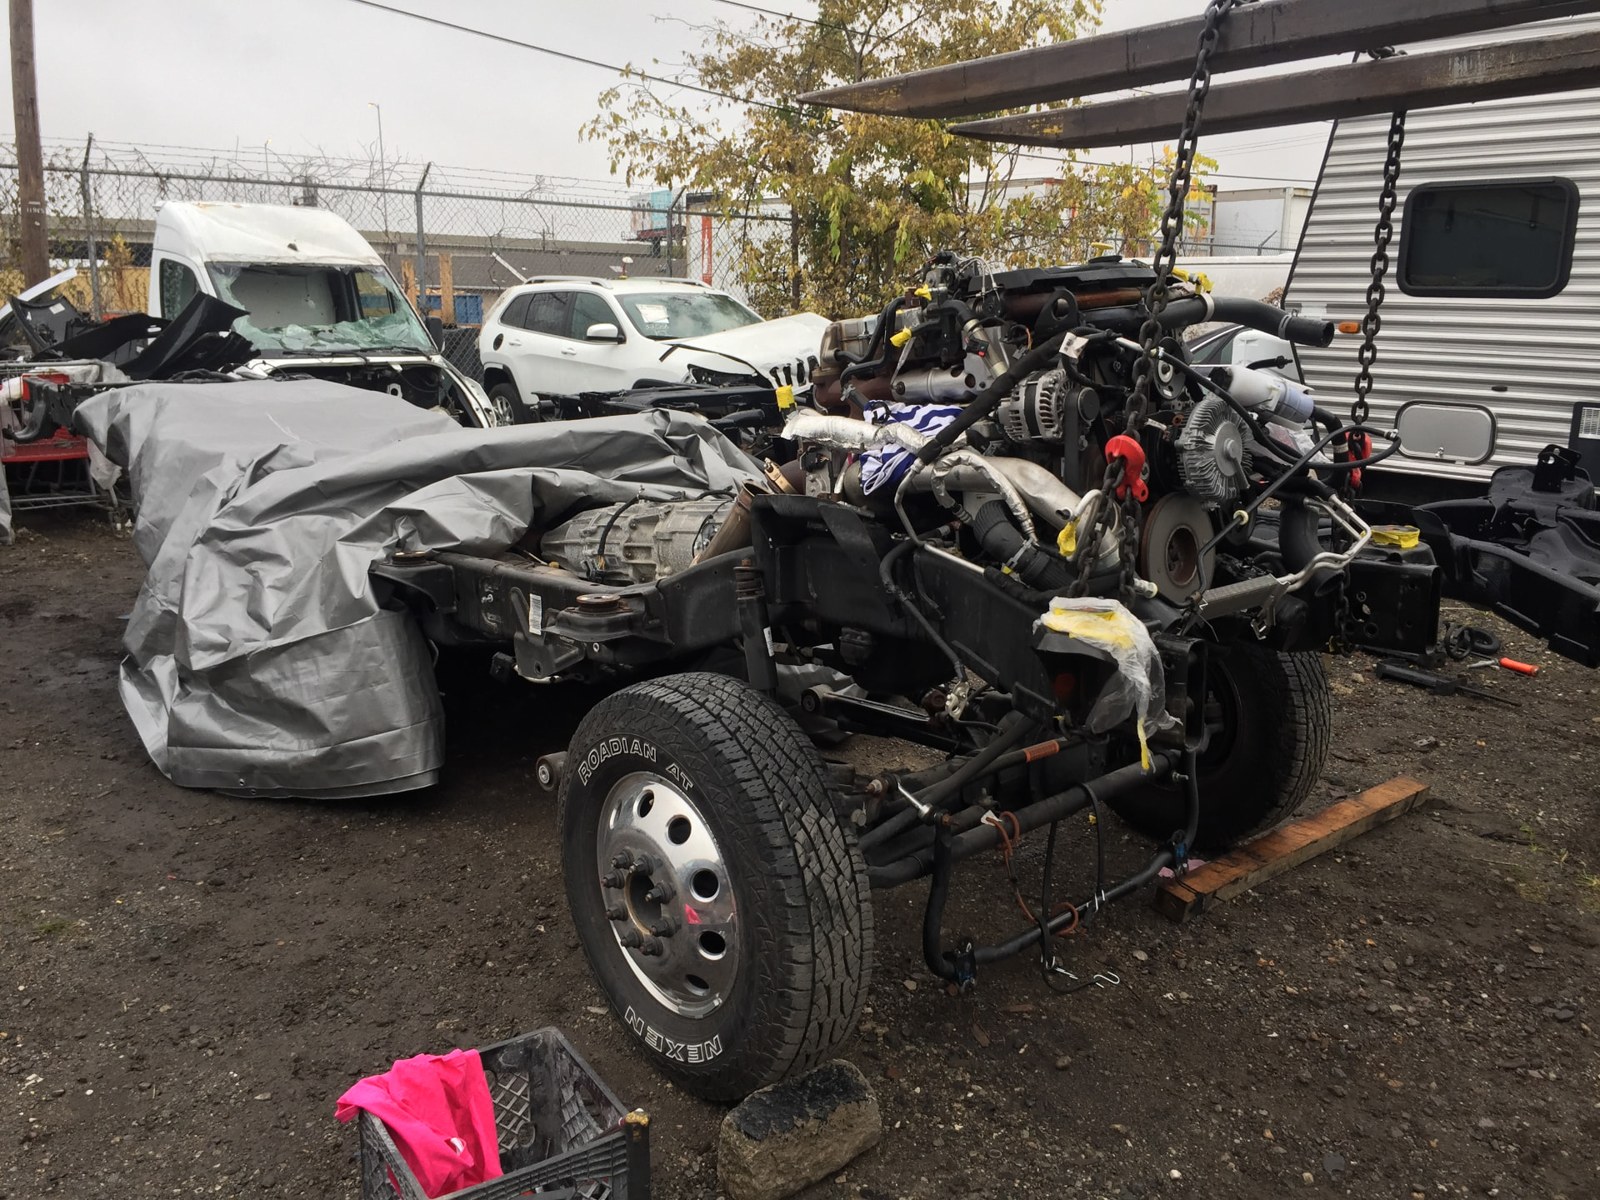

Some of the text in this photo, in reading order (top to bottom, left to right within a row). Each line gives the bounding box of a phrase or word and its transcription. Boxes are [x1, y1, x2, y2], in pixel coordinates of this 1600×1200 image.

[578, 737, 693, 791] ROADIAN AT
[624, 1005, 723, 1063] NEXEN
